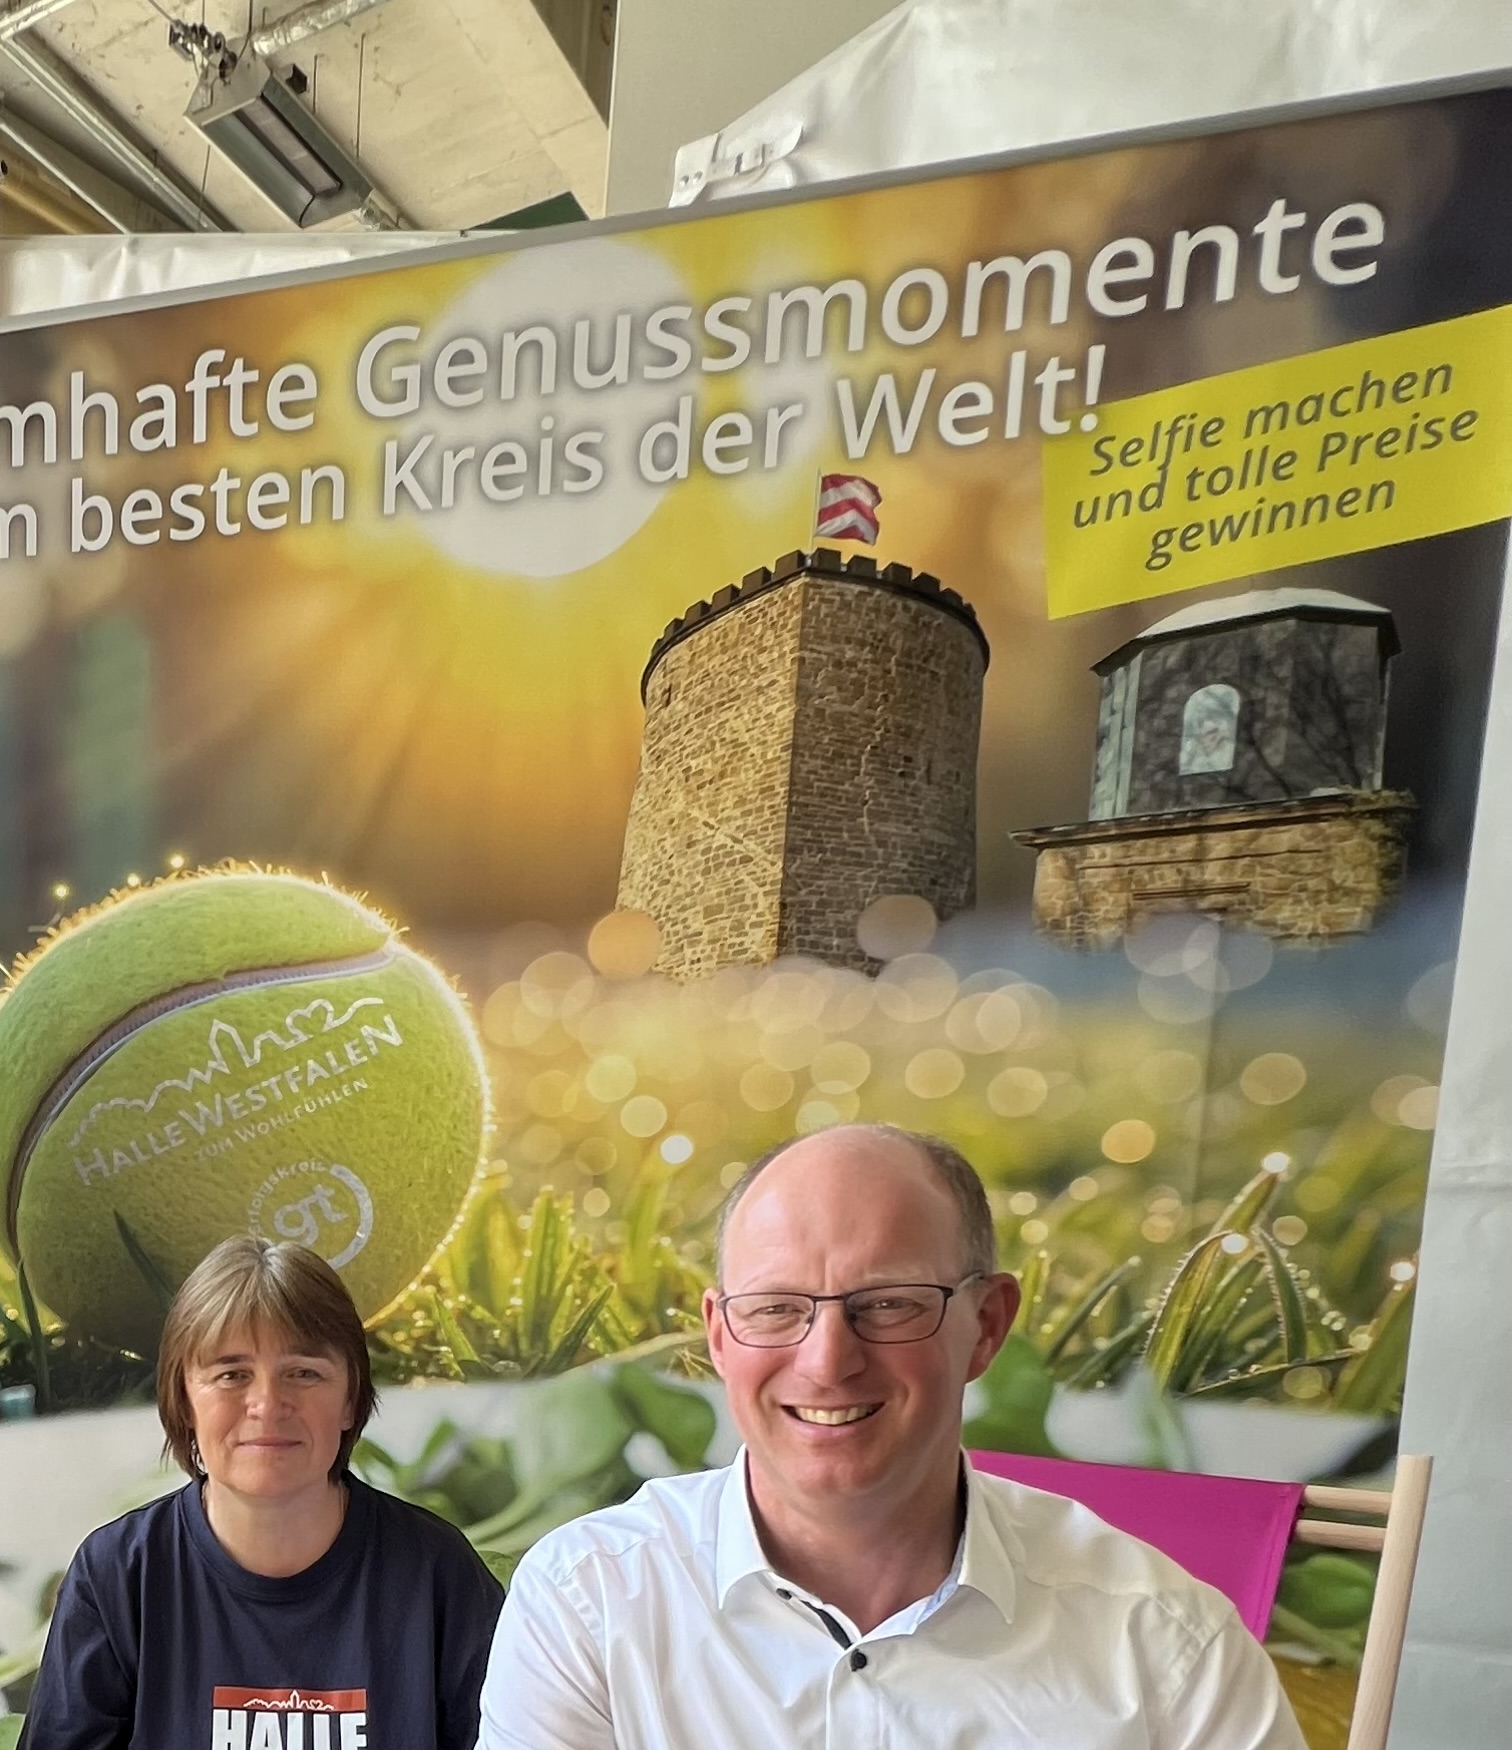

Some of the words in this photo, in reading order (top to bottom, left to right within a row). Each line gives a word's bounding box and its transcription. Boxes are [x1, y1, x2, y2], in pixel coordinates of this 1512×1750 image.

[355, 197, 1386, 419] Genussmomente
[70, 463, 346, 553] besten
[384, 418, 604, 515] Kreis
[638, 398, 803, 483] der
[837, 343, 1106, 459] Welt!
[1073, 470, 1168, 529] und
[1186, 444, 1299, 498] tolle
[1317, 406, 1480, 475] Preise
[1090, 408, 1224, 477] Selfie
[1243, 359, 1453, 437] machen
[1145, 476, 1395, 571] gewinnen
[195, 1137, 233, 1162] ZUM
[237, 1077, 369, 1143] WOHLFÜHLEN
